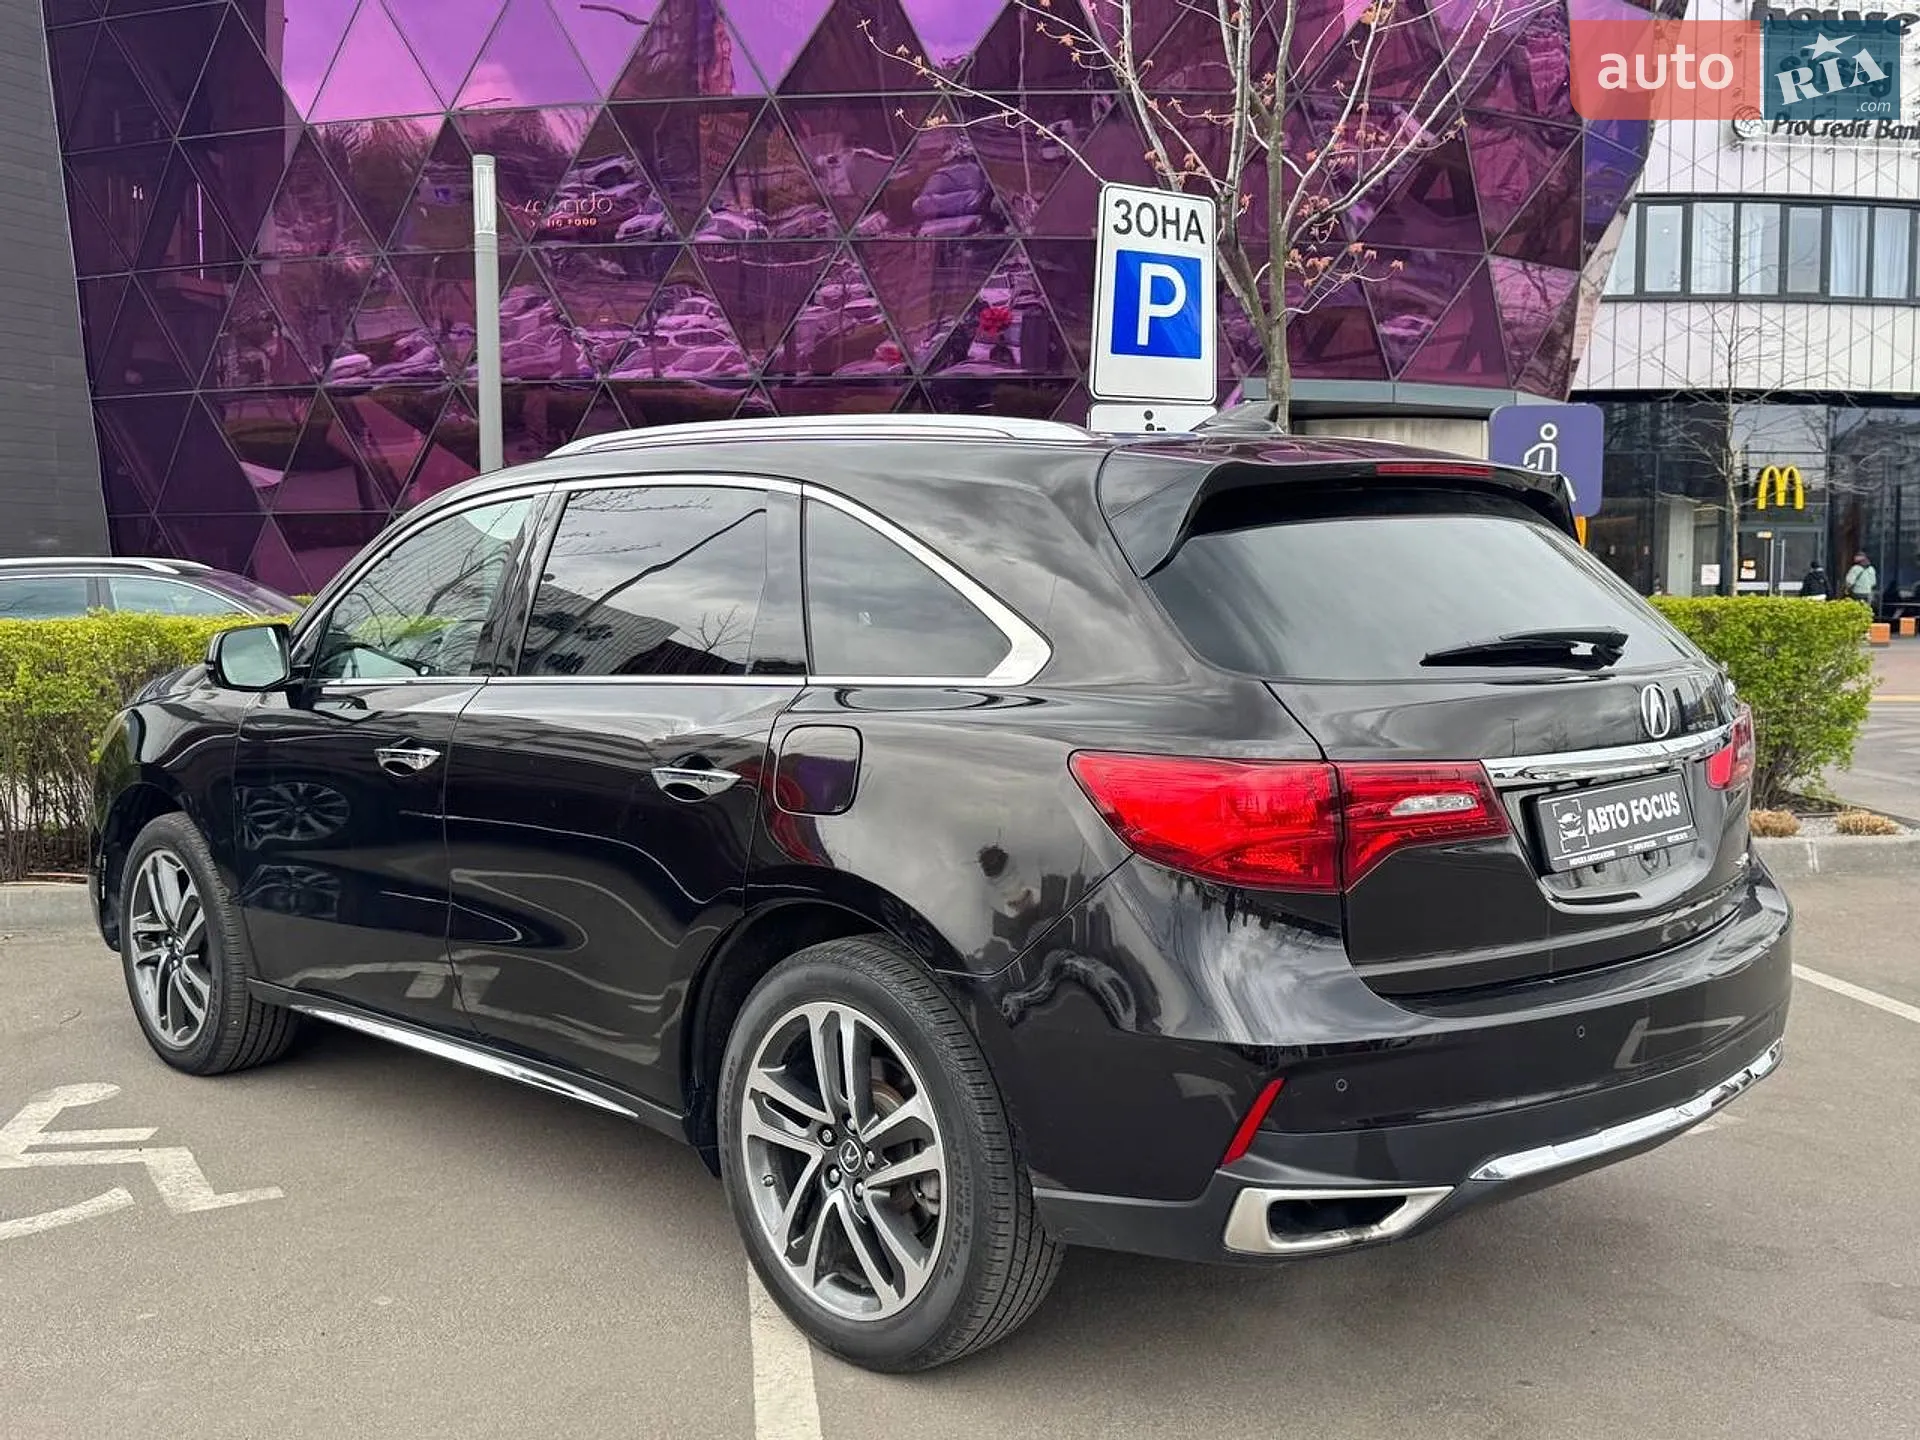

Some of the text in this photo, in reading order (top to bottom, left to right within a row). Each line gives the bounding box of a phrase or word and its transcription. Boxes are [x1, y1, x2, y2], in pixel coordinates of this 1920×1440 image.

[1771, 111, 1873, 139] ProCredit
[1113, 199, 1205, 244] ЗОНА
[1630, 792, 1680, 824] FOCUS
